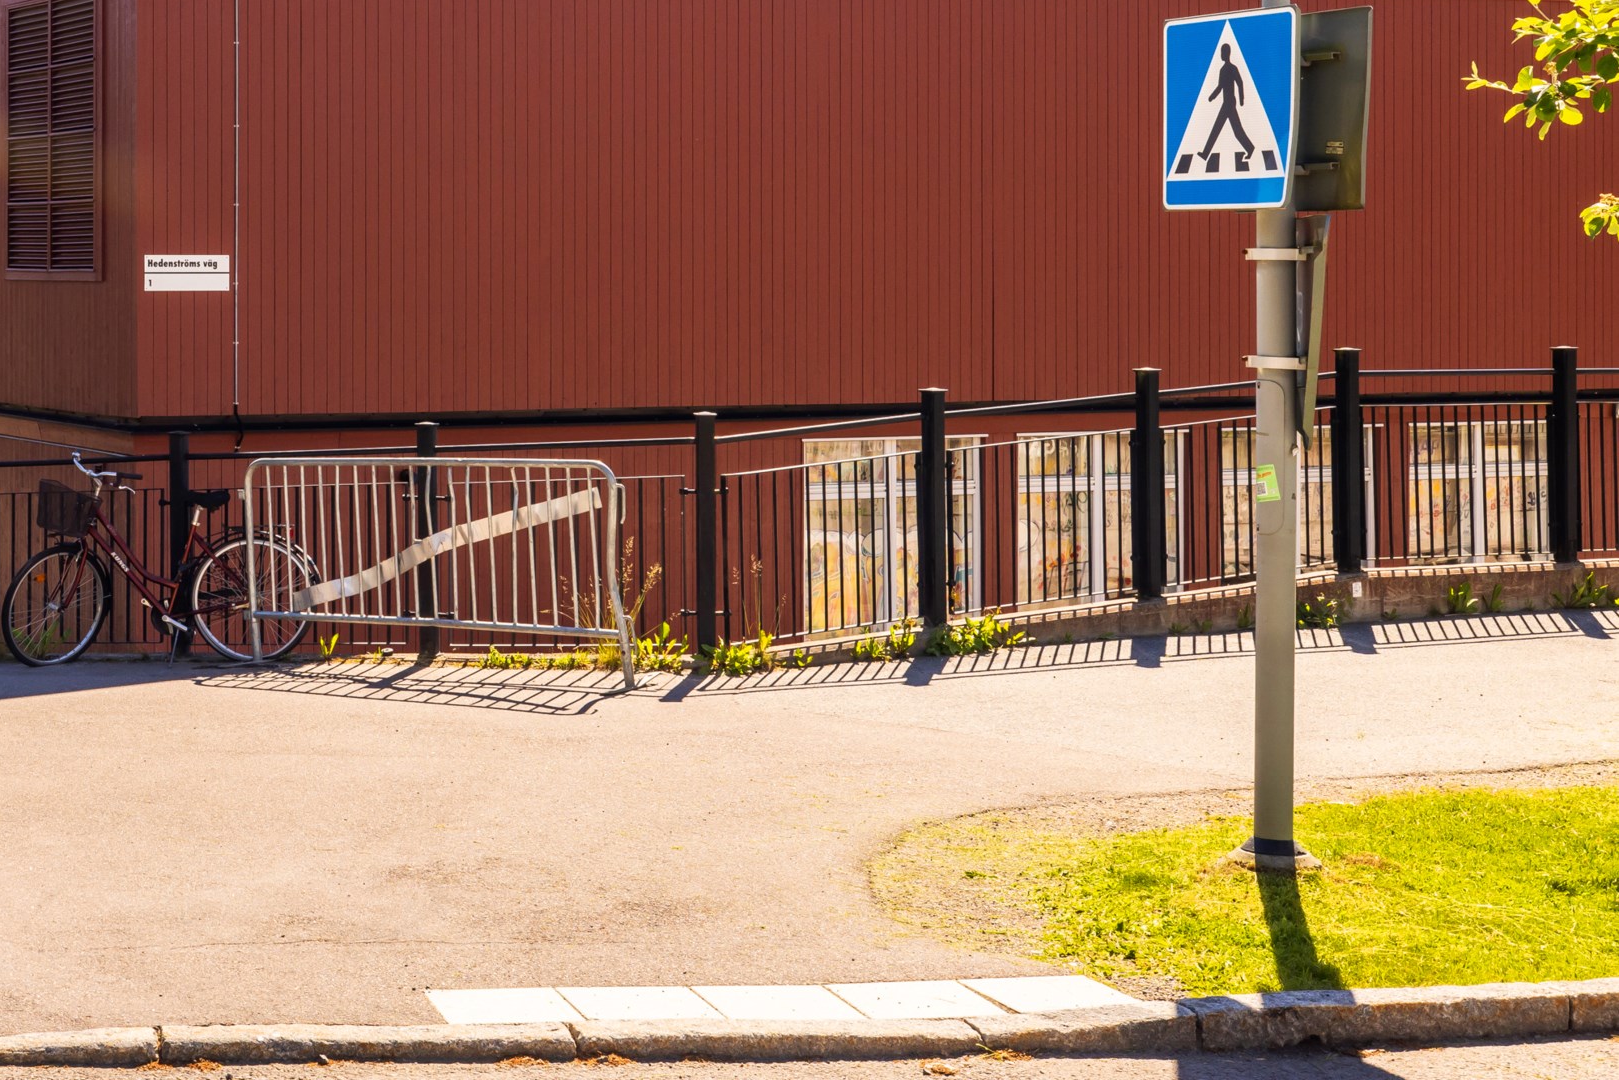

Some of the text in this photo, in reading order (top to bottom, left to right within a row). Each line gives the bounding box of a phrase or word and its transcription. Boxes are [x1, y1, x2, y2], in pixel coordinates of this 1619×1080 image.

[147, 258, 218, 270] Hedenströms väg
[148, 279, 152, 287] 1
